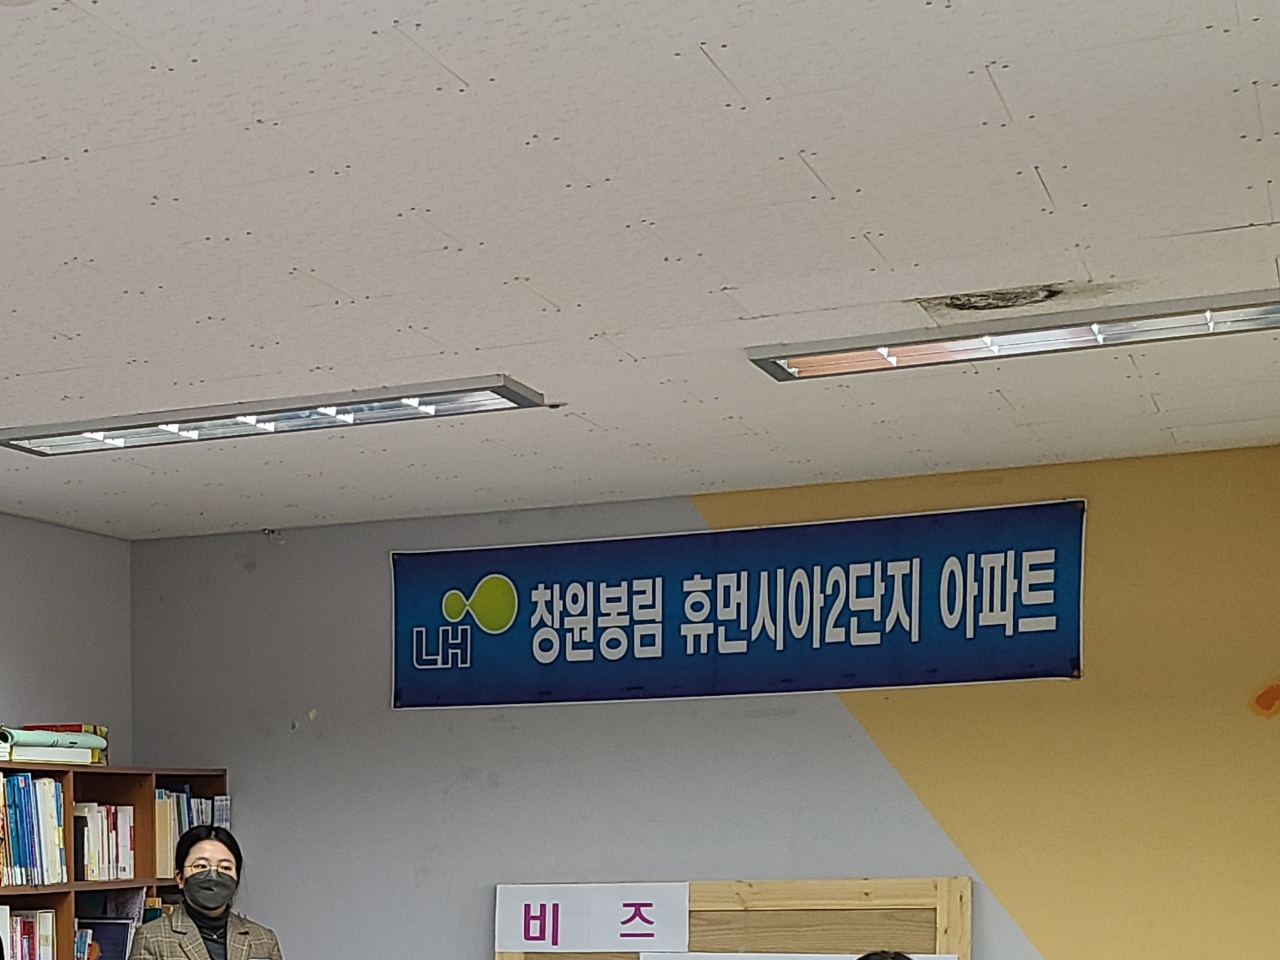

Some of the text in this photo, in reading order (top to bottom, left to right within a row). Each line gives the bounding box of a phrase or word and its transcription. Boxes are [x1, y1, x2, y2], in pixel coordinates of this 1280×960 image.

[412, 624, 472, 669] LH
[529, 547, 1057, 665] 창원봉림 휴먼시아2단지 아파트
